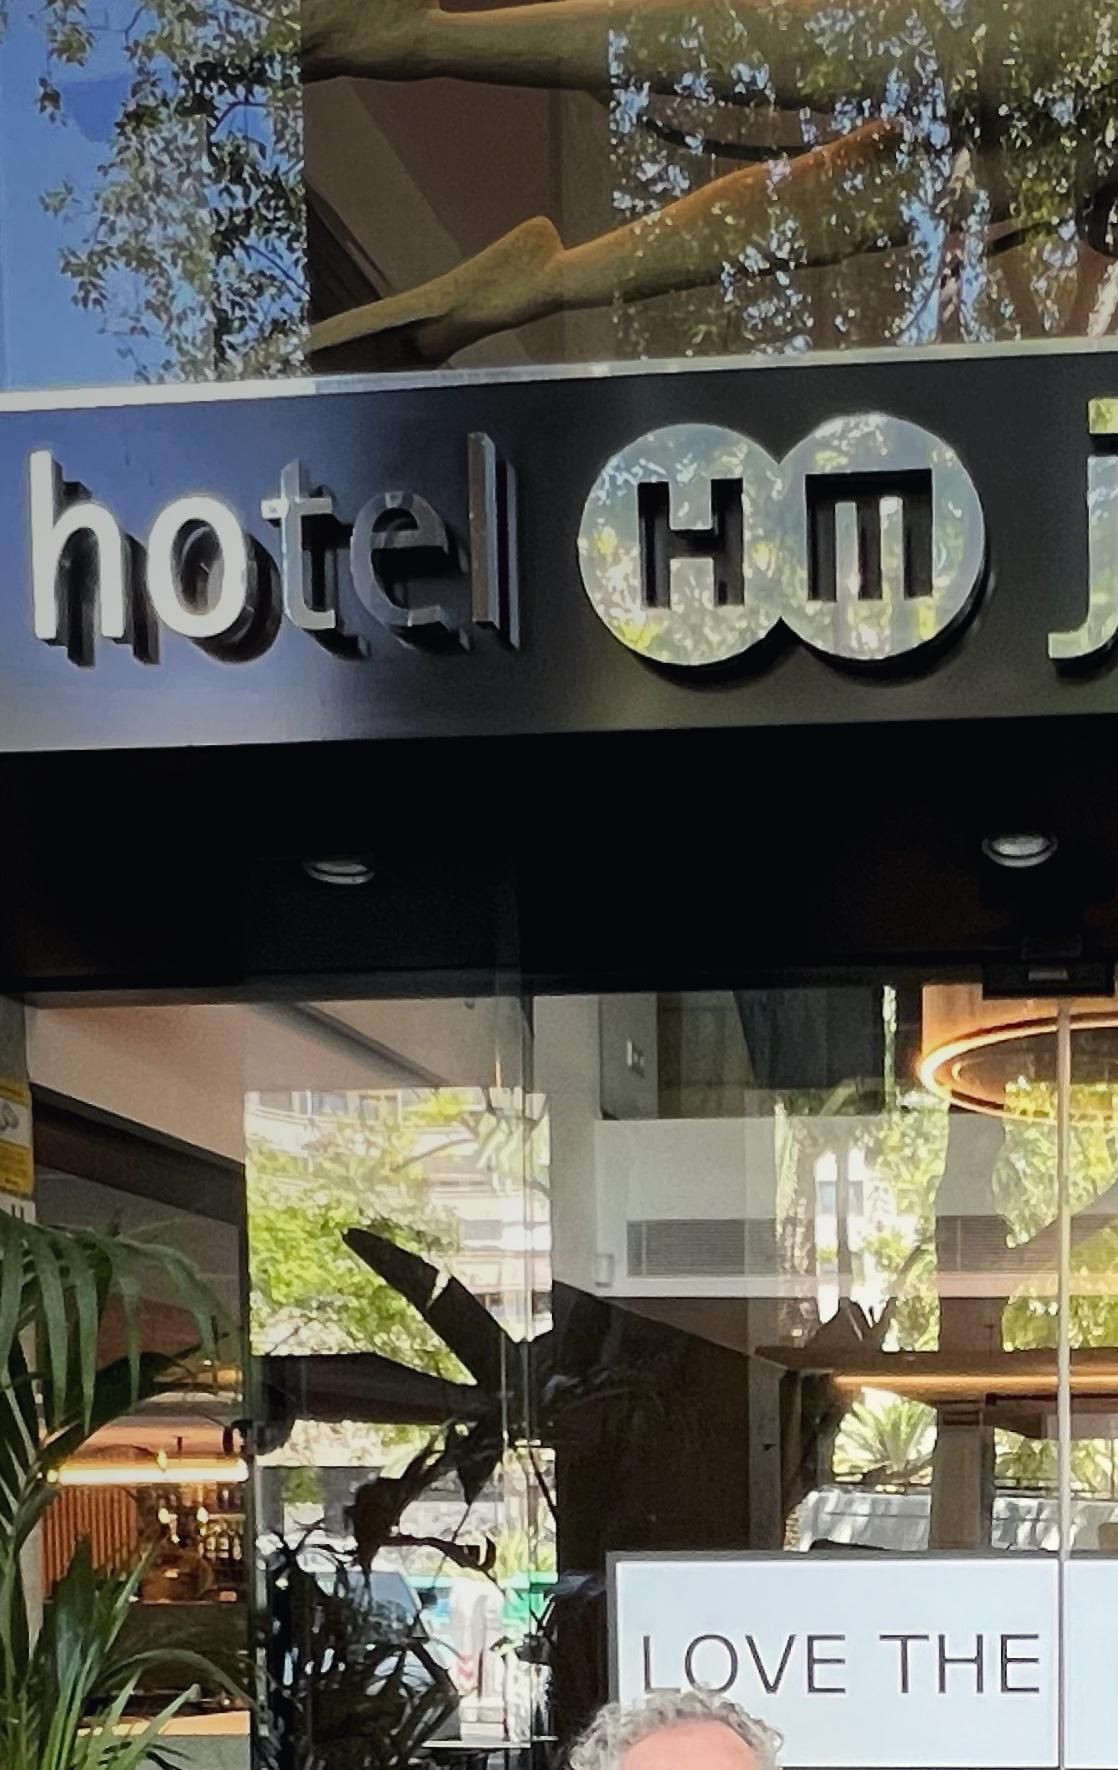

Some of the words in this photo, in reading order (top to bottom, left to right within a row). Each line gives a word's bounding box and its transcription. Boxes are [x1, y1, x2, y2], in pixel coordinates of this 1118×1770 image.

[28, 430, 520, 650] hotel
[640, 1632, 847, 1697] LOVE
[880, 1632, 1041, 1695] THE
